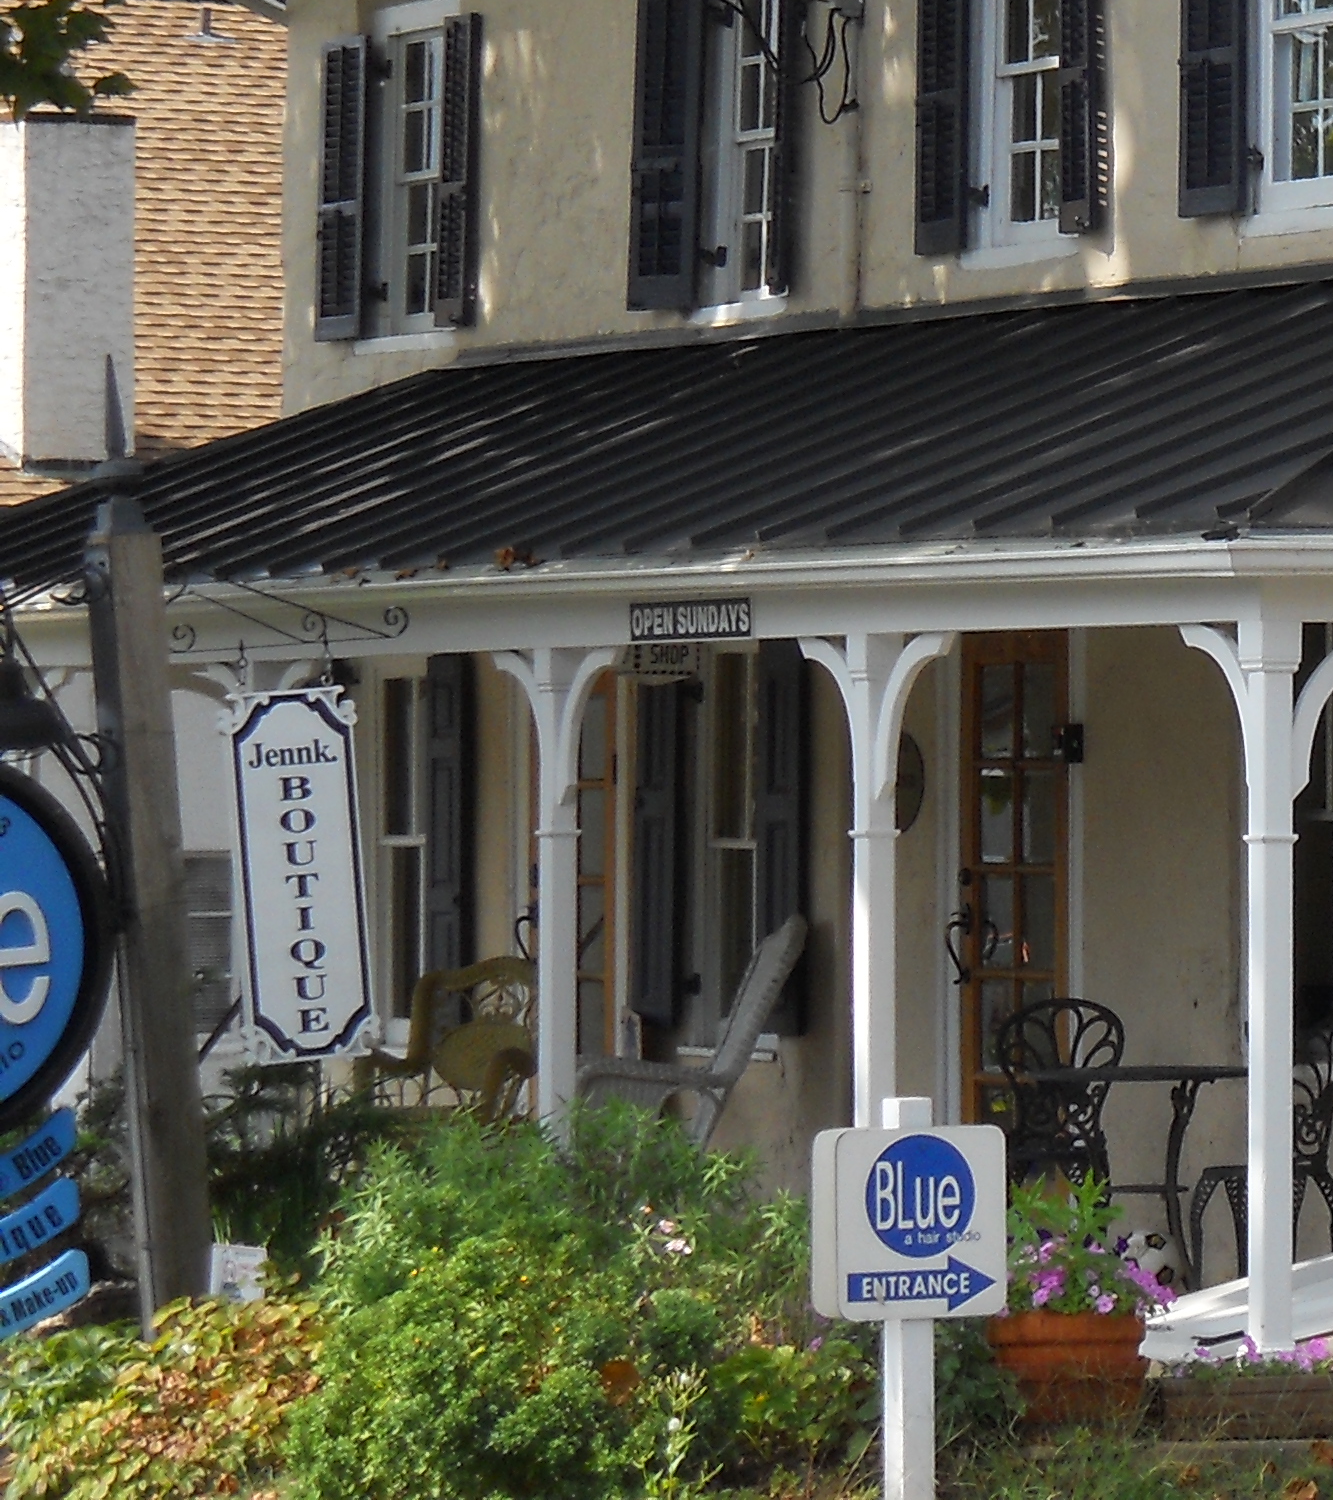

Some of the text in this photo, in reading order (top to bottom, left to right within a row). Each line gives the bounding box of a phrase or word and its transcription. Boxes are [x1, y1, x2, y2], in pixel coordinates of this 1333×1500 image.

[631, 602, 750, 637] OPEN SUNDAYS
[650, 644, 690, 665] SHOP
[248, 738, 338, 769] Jennk.
[278, 775, 330, 1034] BOUTIQUE
[11, 1136, 62, 1181] Blue
[903, 1229, 982, 1245] a hair studio
[10, 1271, 79, 1322] Make-up
[861, 1272, 971, 1299] ENTRANCE
